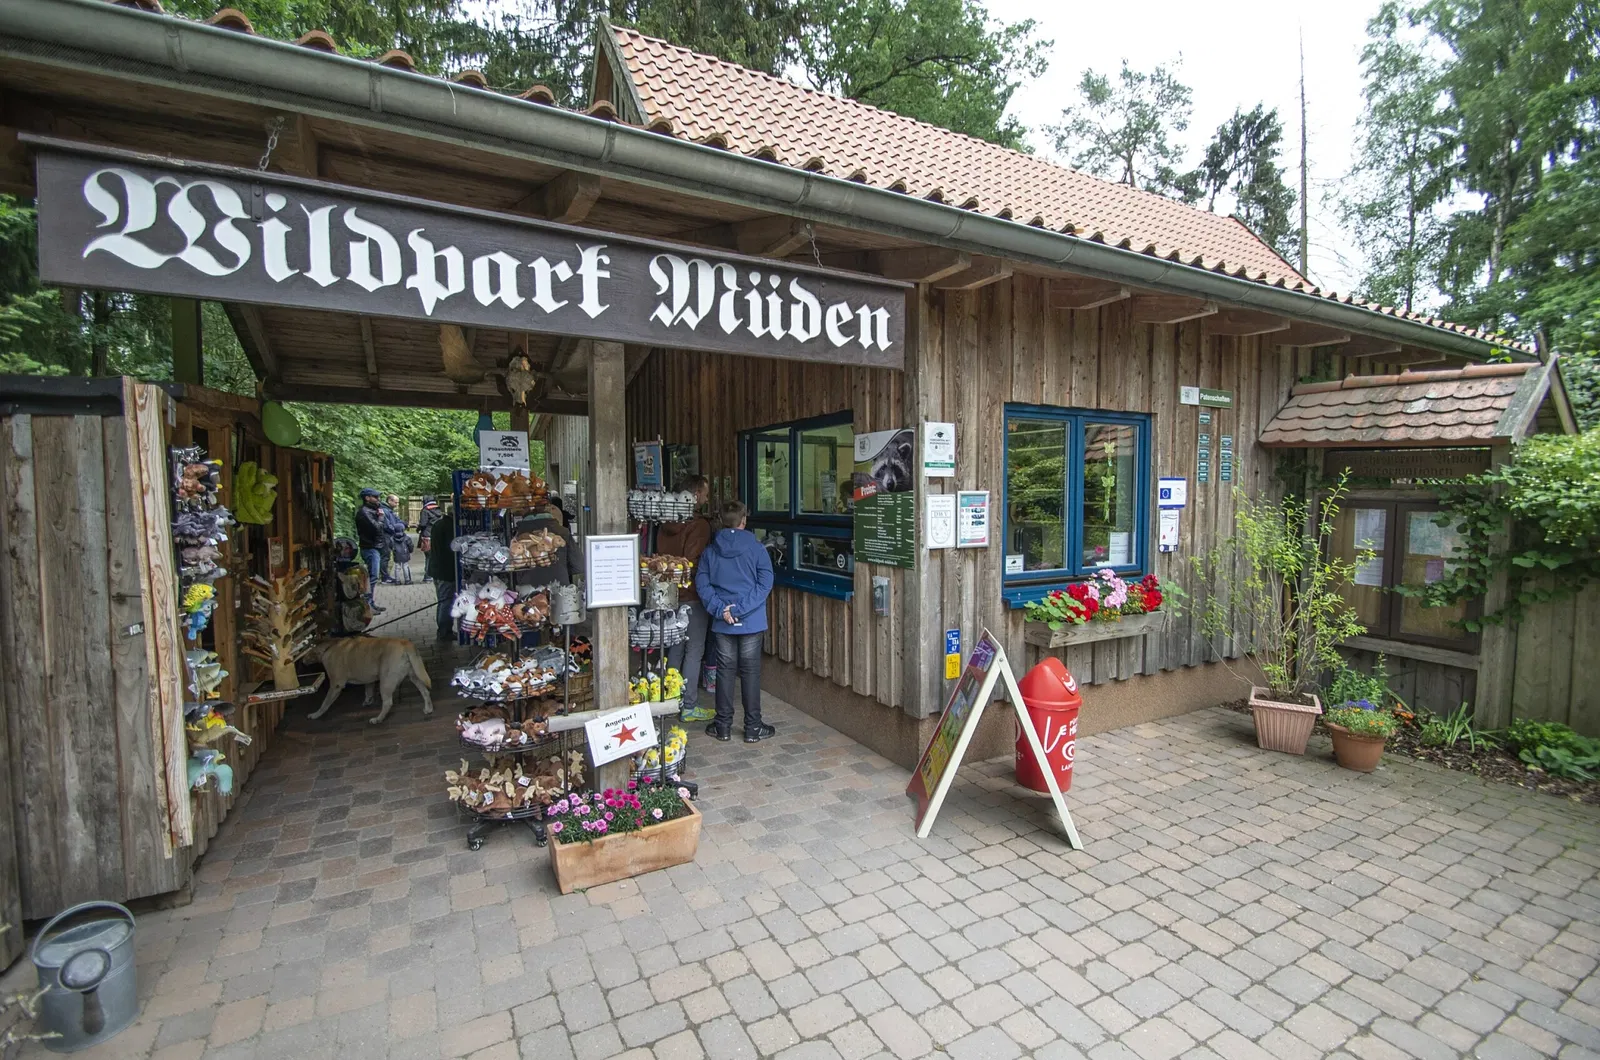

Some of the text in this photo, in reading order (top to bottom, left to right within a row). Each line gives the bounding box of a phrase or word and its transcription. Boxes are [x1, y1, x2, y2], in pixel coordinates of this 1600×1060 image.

[82, 167, 895, 353] Wildpark Müden
[605, 714, 633, 728] Angebot
